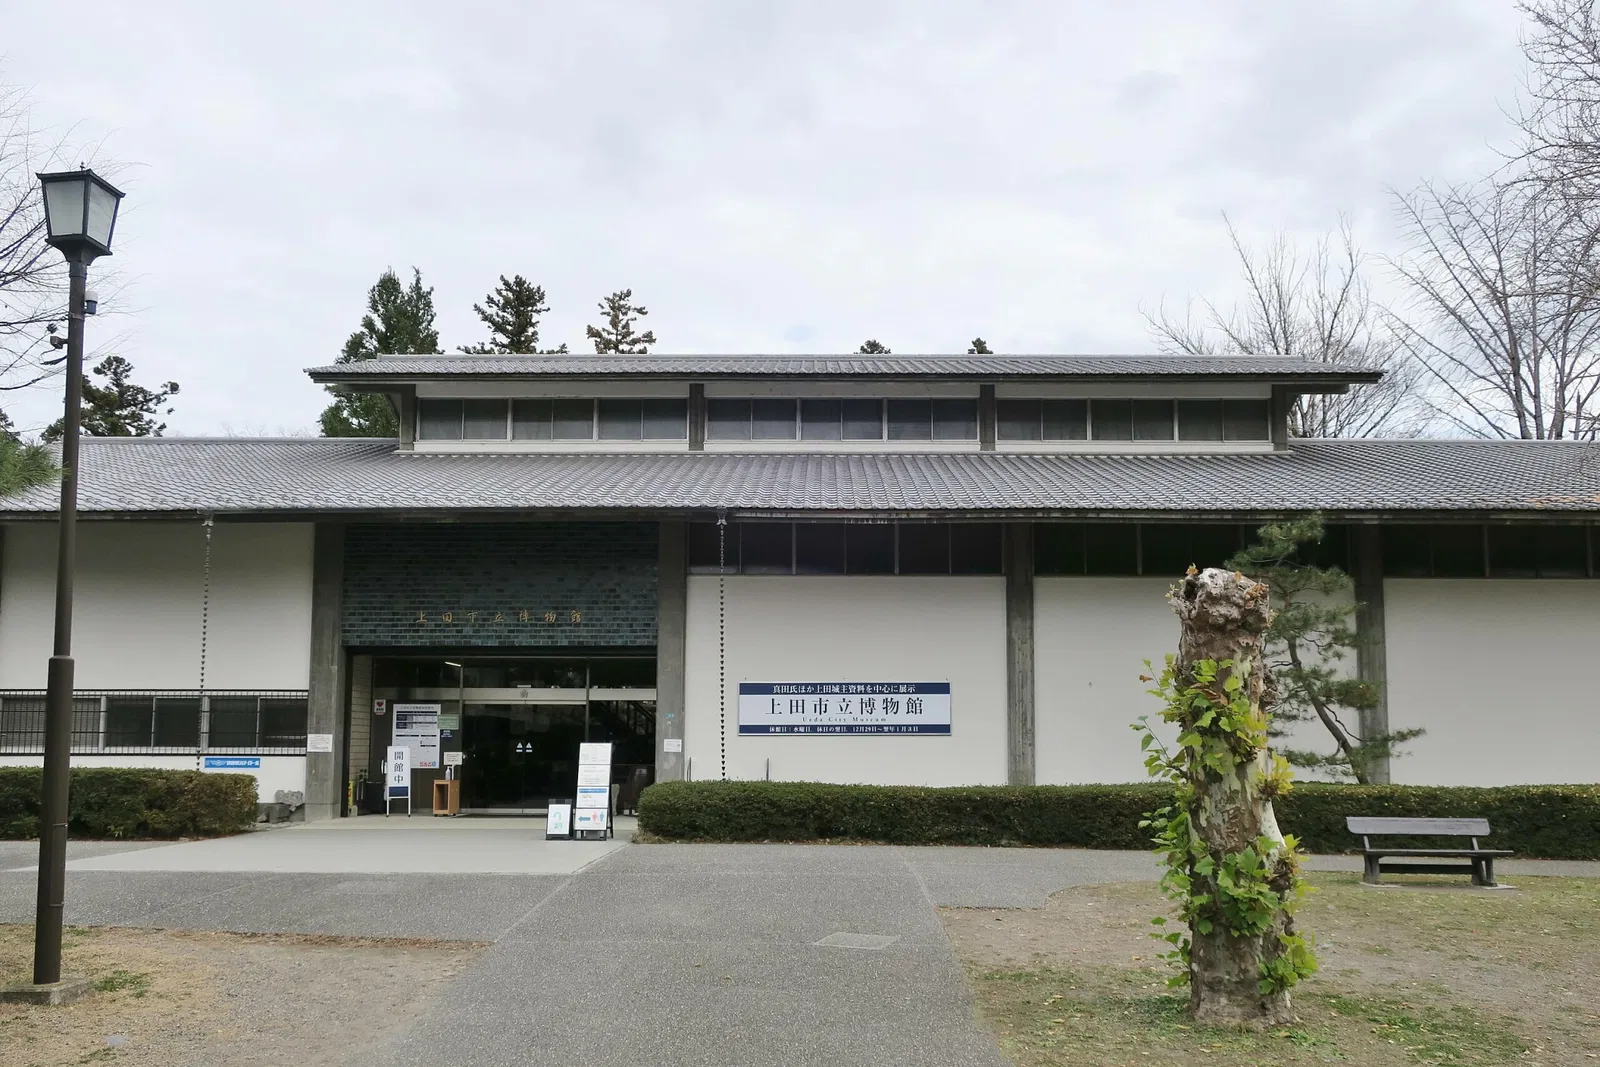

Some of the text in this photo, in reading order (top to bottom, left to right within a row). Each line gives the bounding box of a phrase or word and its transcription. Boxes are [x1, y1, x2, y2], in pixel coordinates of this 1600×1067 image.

[416, 610, 582, 623] 上田市立博物館
[773, 684, 916, 694] 真田氏ほか上田城主資料を中心に展示
[765, 697, 923, 716] 上田市立博物館
[394, 751, 404, 784] 開館中
